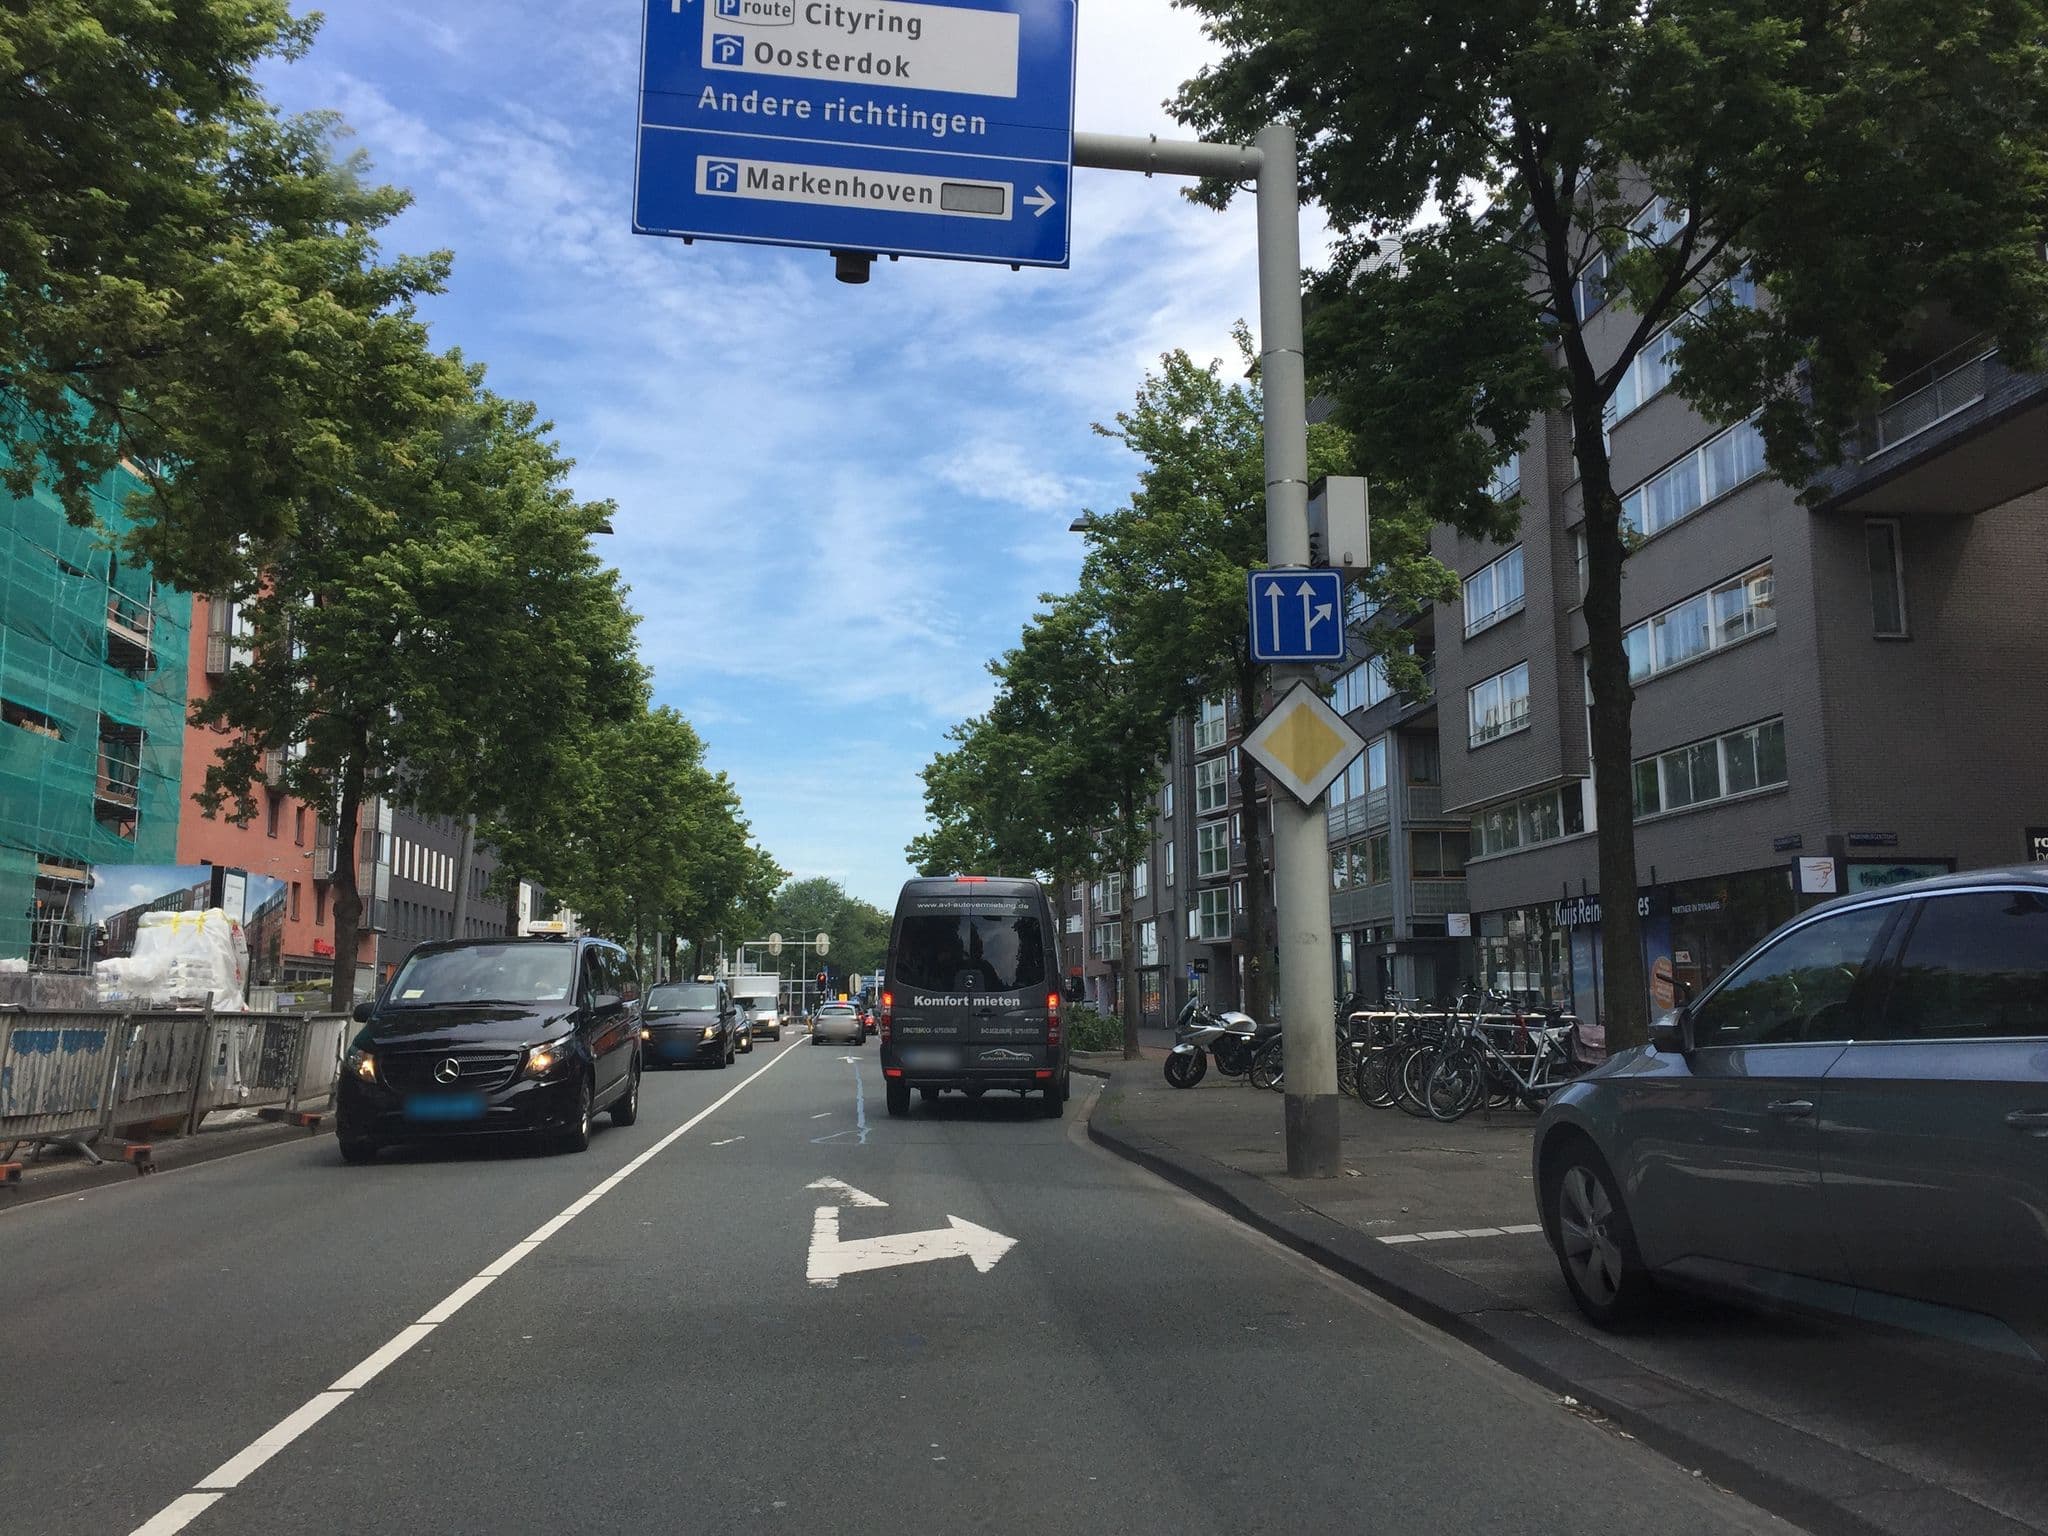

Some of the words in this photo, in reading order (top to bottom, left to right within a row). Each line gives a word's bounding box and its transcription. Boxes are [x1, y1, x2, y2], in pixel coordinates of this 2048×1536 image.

[744, 0, 792, 17] route
[805, 3, 922, 40] Cityring
[754, 41, 911, 79] Oosterdok
[698, 85, 811, 118] Andere
[824, 97, 987, 137] richtingen
[746, 166, 933, 205] Markenhoven
[1555, 900, 1578, 932] Kuijs
[914, 996, 969, 1007] Komfort
[973, 996, 1020, 1007] mieten
